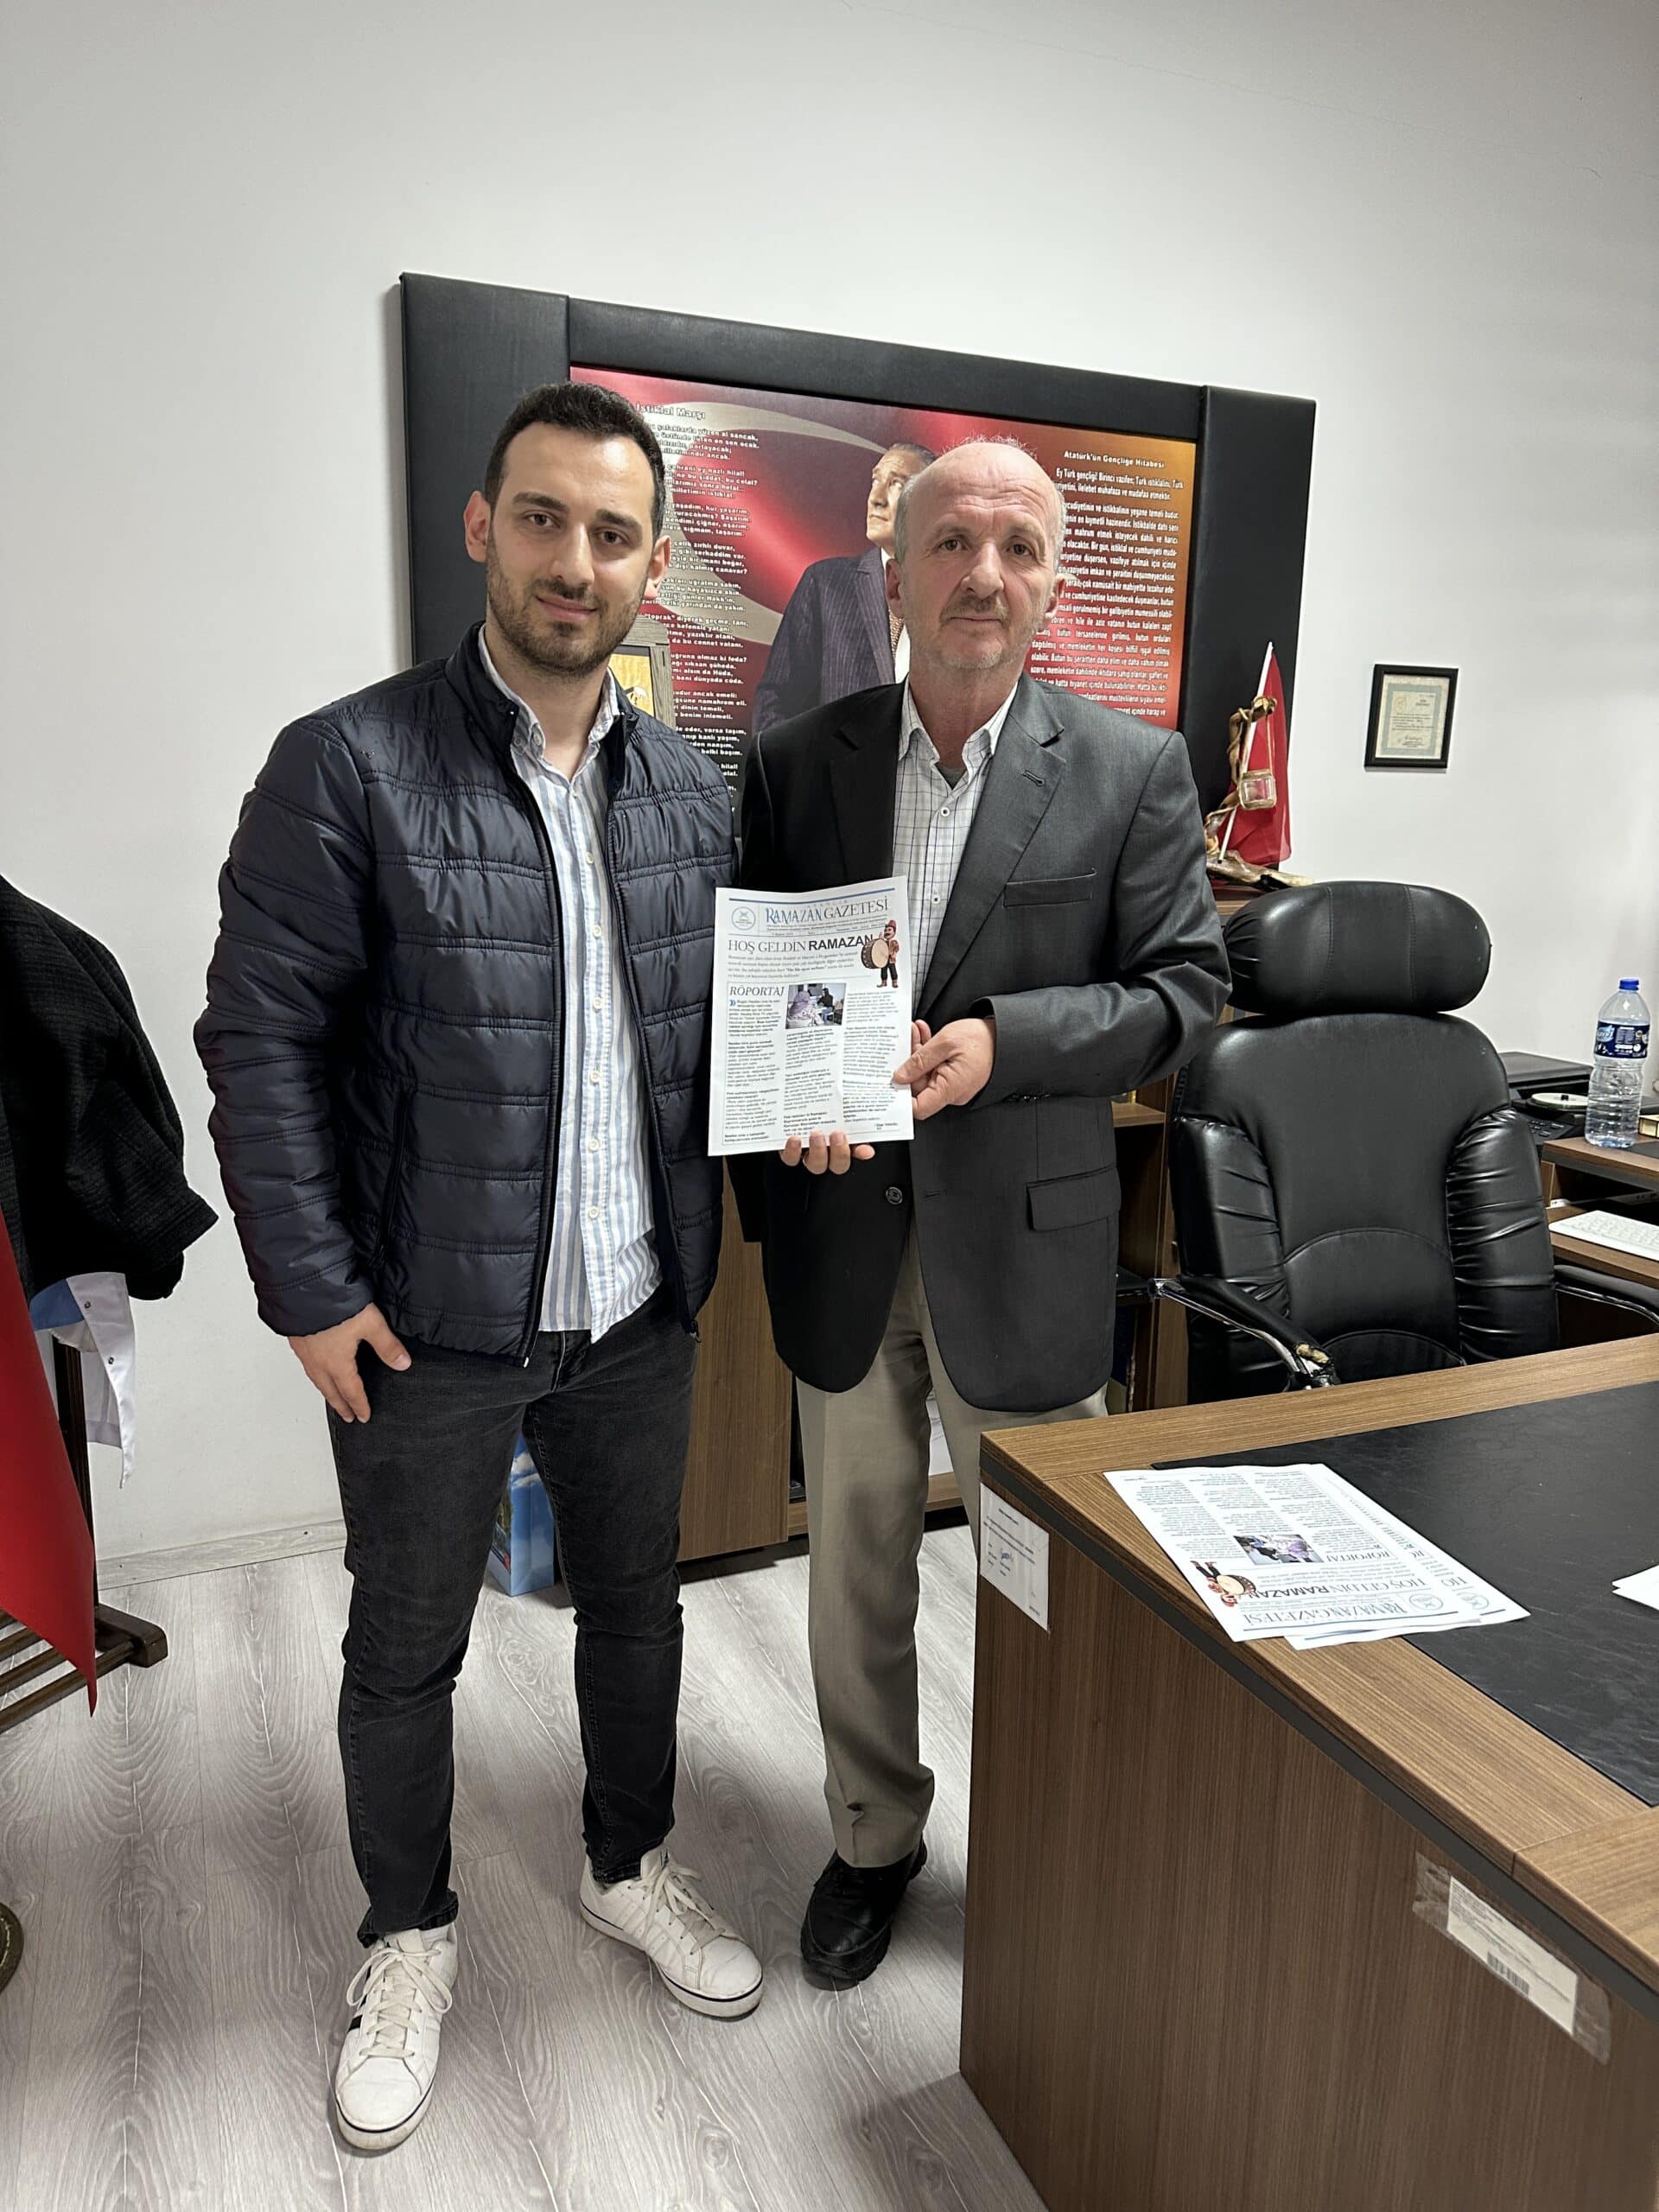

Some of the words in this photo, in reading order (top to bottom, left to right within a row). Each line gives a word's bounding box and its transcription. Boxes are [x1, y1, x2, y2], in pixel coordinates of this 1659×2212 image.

[766, 906, 822, 925] RAMAZAN
[823, 895, 890, 918] GAZETESİ
[728, 940, 755, 955] HOŞ
[758, 938, 806, 952] GELDİN
[809, 934, 874, 951] RAMAZAN
[729, 985, 785, 997] RÖPORTAJ
[1249, 1585, 1329, 1599] RAMAZAN
